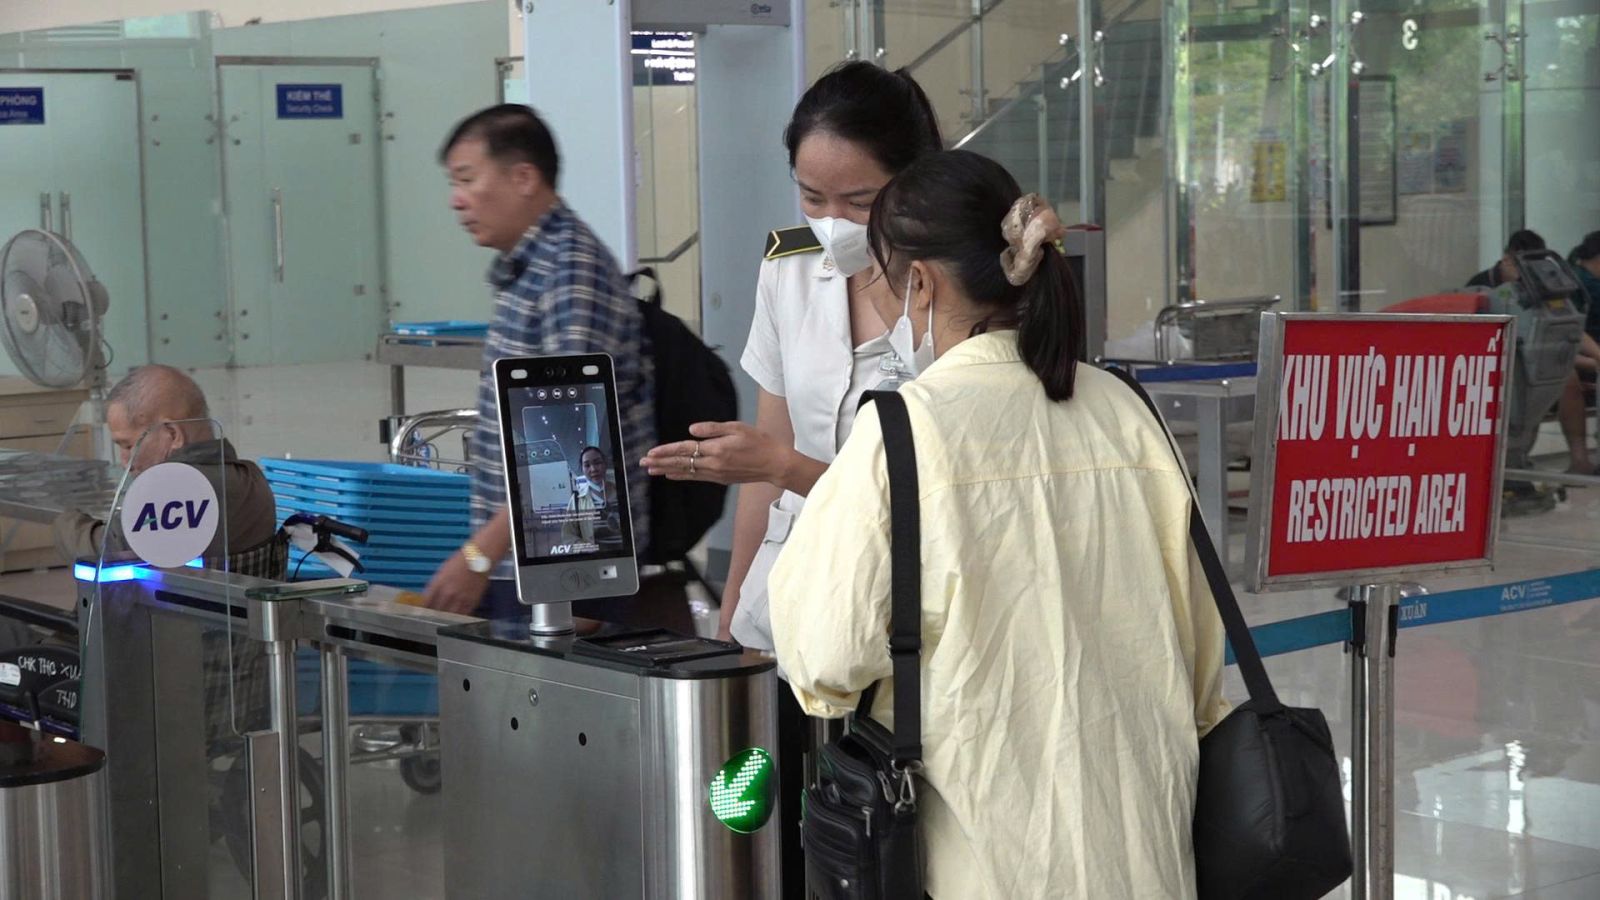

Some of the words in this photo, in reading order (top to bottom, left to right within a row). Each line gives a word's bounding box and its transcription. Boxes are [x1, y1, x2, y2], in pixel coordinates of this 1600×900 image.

[1277, 354, 1331, 441] KHU
[1335, 346, 1387, 459] VỰC
[1389, 355, 1446, 457] HẠN
[1447, 328, 1502, 438] CHẾ
[131, 499, 210, 532] ACV
[1286, 474, 1413, 543] RESTRICTED
[1413, 472, 1467, 535] AREA
[550, 544, 571, 555] ACV
[1501, 585, 1527, 601] ACV
